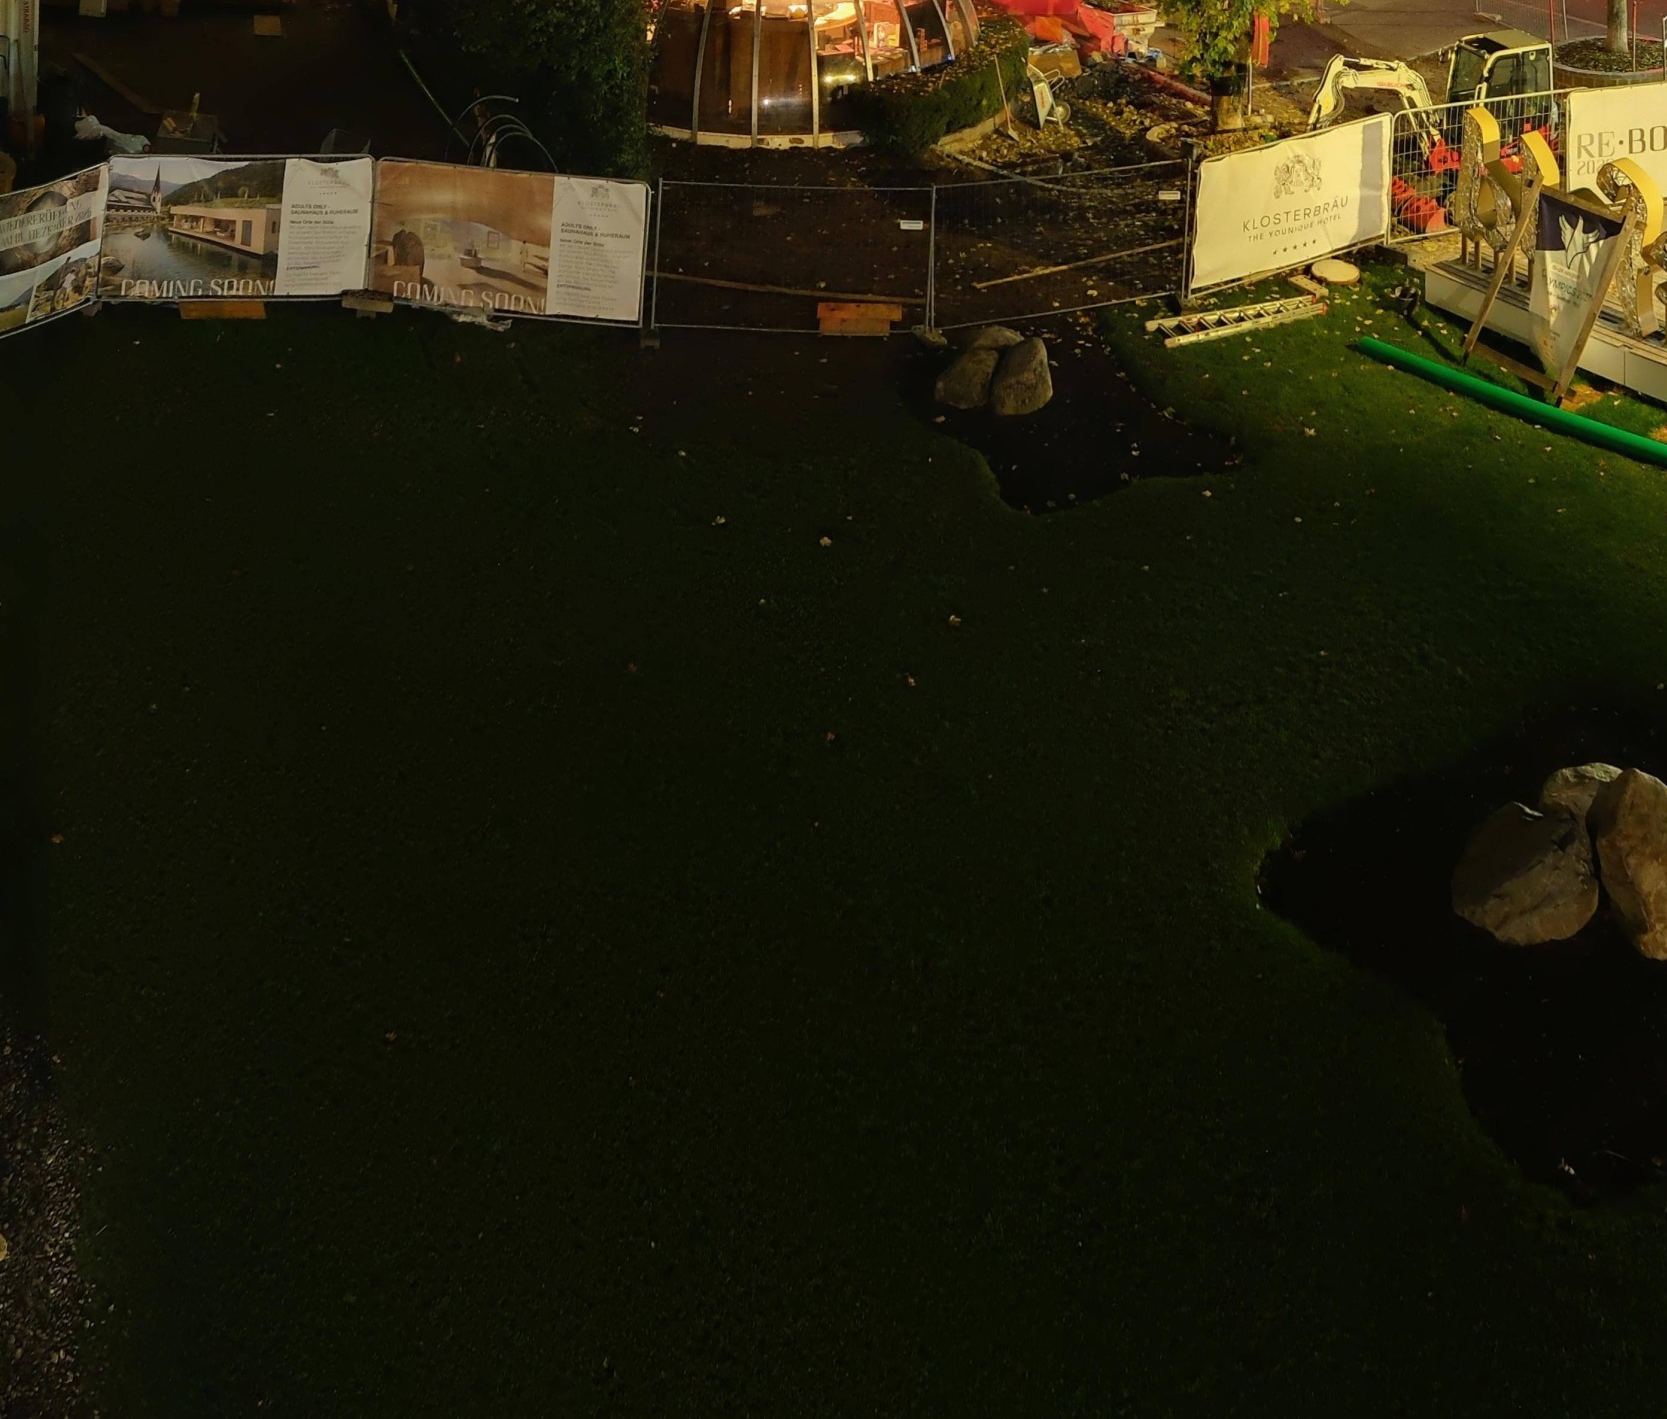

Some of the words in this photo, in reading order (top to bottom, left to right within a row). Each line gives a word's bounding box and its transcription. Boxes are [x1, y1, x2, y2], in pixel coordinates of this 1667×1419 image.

[1242, 195, 1349, 233] KLOSTERBRÄU
[1248, 233, 1264, 243] THE
[1269, 221, 1315, 238] YOUNIQUE
[1317, 213, 1342, 229] HOTEL
